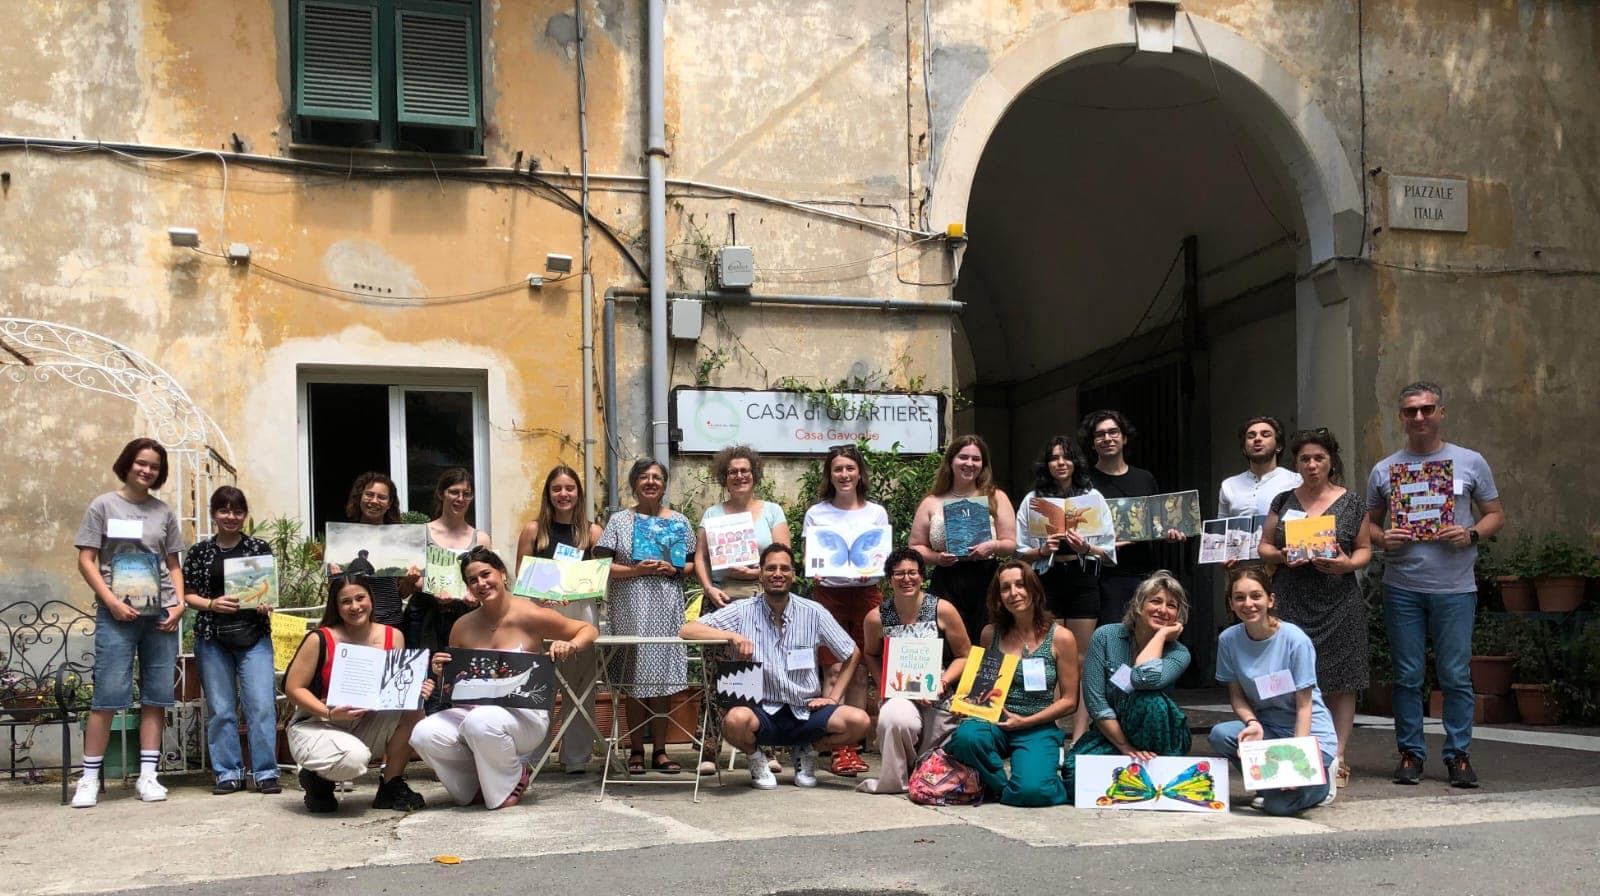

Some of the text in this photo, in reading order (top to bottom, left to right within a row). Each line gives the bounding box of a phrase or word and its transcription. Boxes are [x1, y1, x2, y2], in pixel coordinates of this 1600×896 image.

[1404, 184, 1453, 200] PIAZZALE
[1414, 206, 1444, 220] ITALIA
[746, 403, 929, 422] CASA di QUARTIERE
[795, 428, 824, 440] Casa
[961, 508, 971, 518] M
